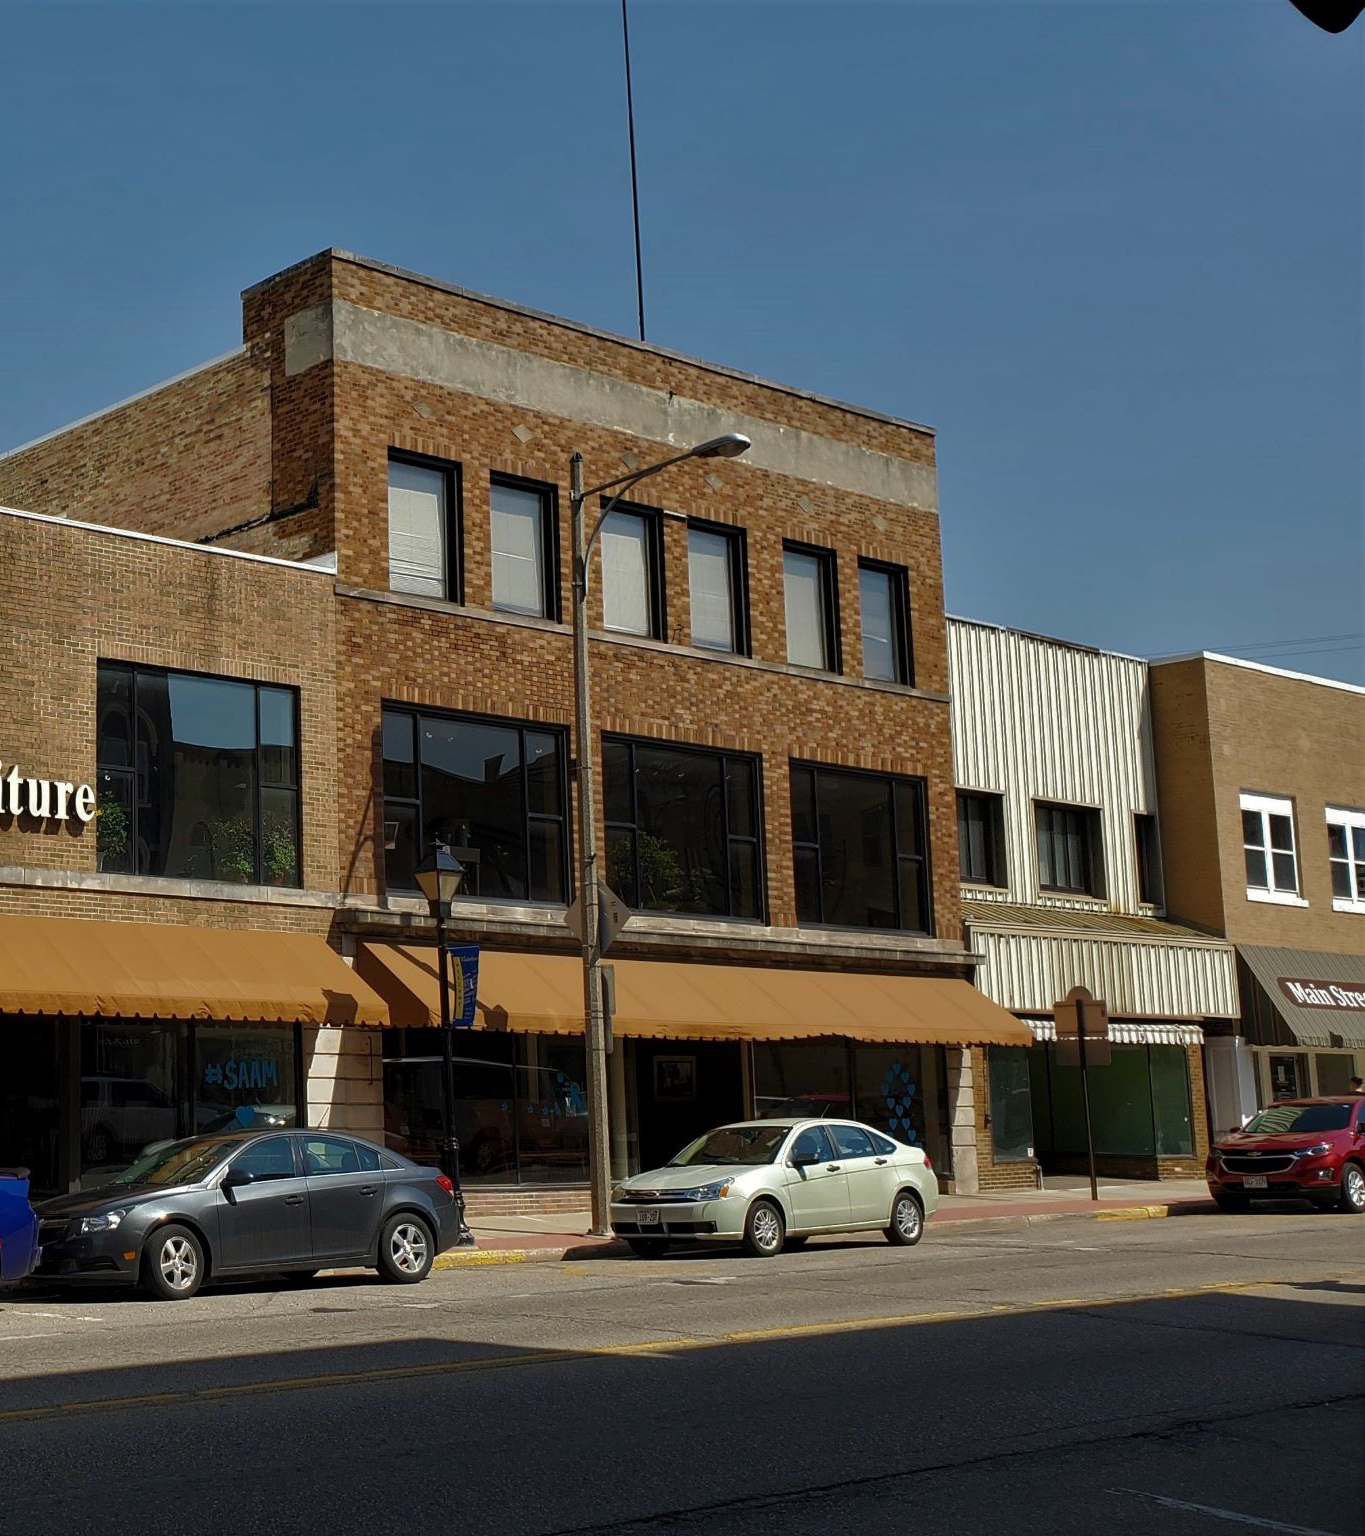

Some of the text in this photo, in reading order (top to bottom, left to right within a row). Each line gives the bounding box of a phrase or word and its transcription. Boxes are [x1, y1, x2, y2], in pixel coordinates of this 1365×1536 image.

[1285, 982, 1365, 1008] Main Stre
[204, 1058, 278, 1090] #SAAM
